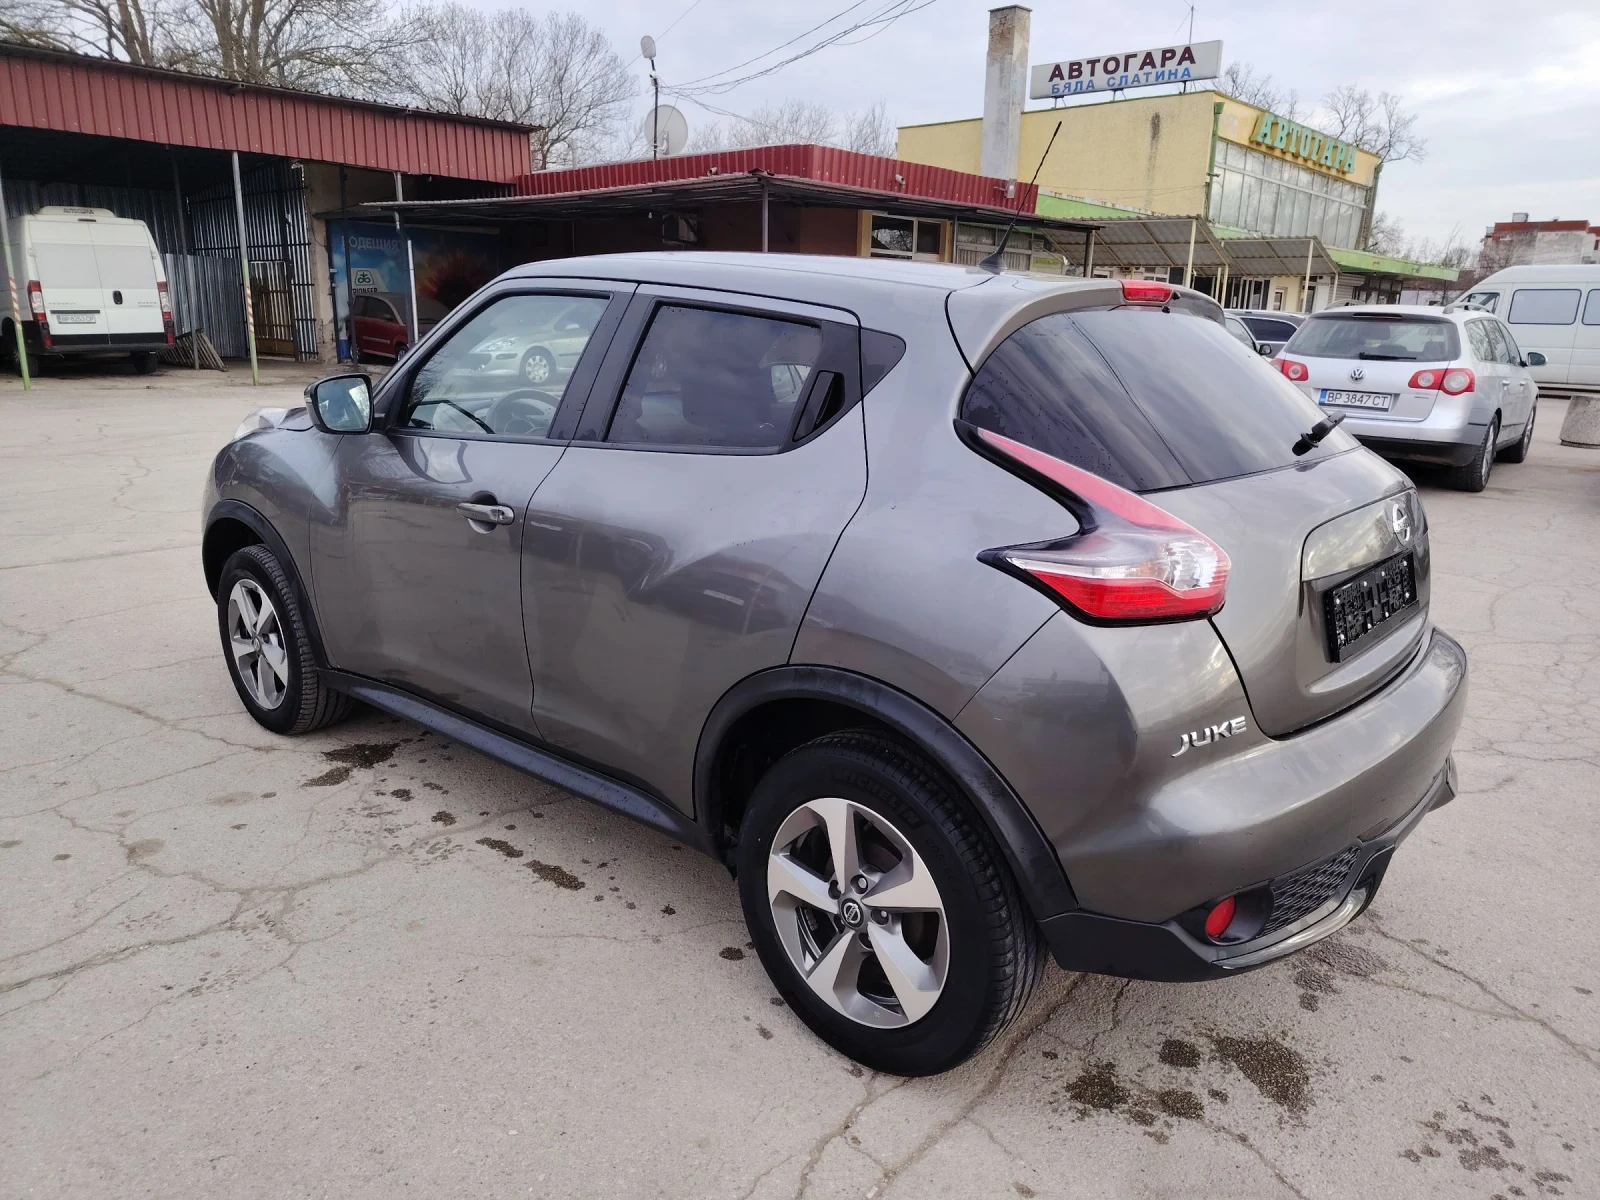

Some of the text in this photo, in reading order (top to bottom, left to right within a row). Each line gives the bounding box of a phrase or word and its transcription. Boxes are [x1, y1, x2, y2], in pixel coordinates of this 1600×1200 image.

[1048, 46, 1196, 82] АВТОГАРА
[1051, 67, 1192, 95] БЯЛА СЛАТИНА
[1254, 112, 1358, 174] АВТОГАРА
[1327, 392, 1389, 407] BP 3847 CT
[1170, 715, 1247, 758] JUKE
